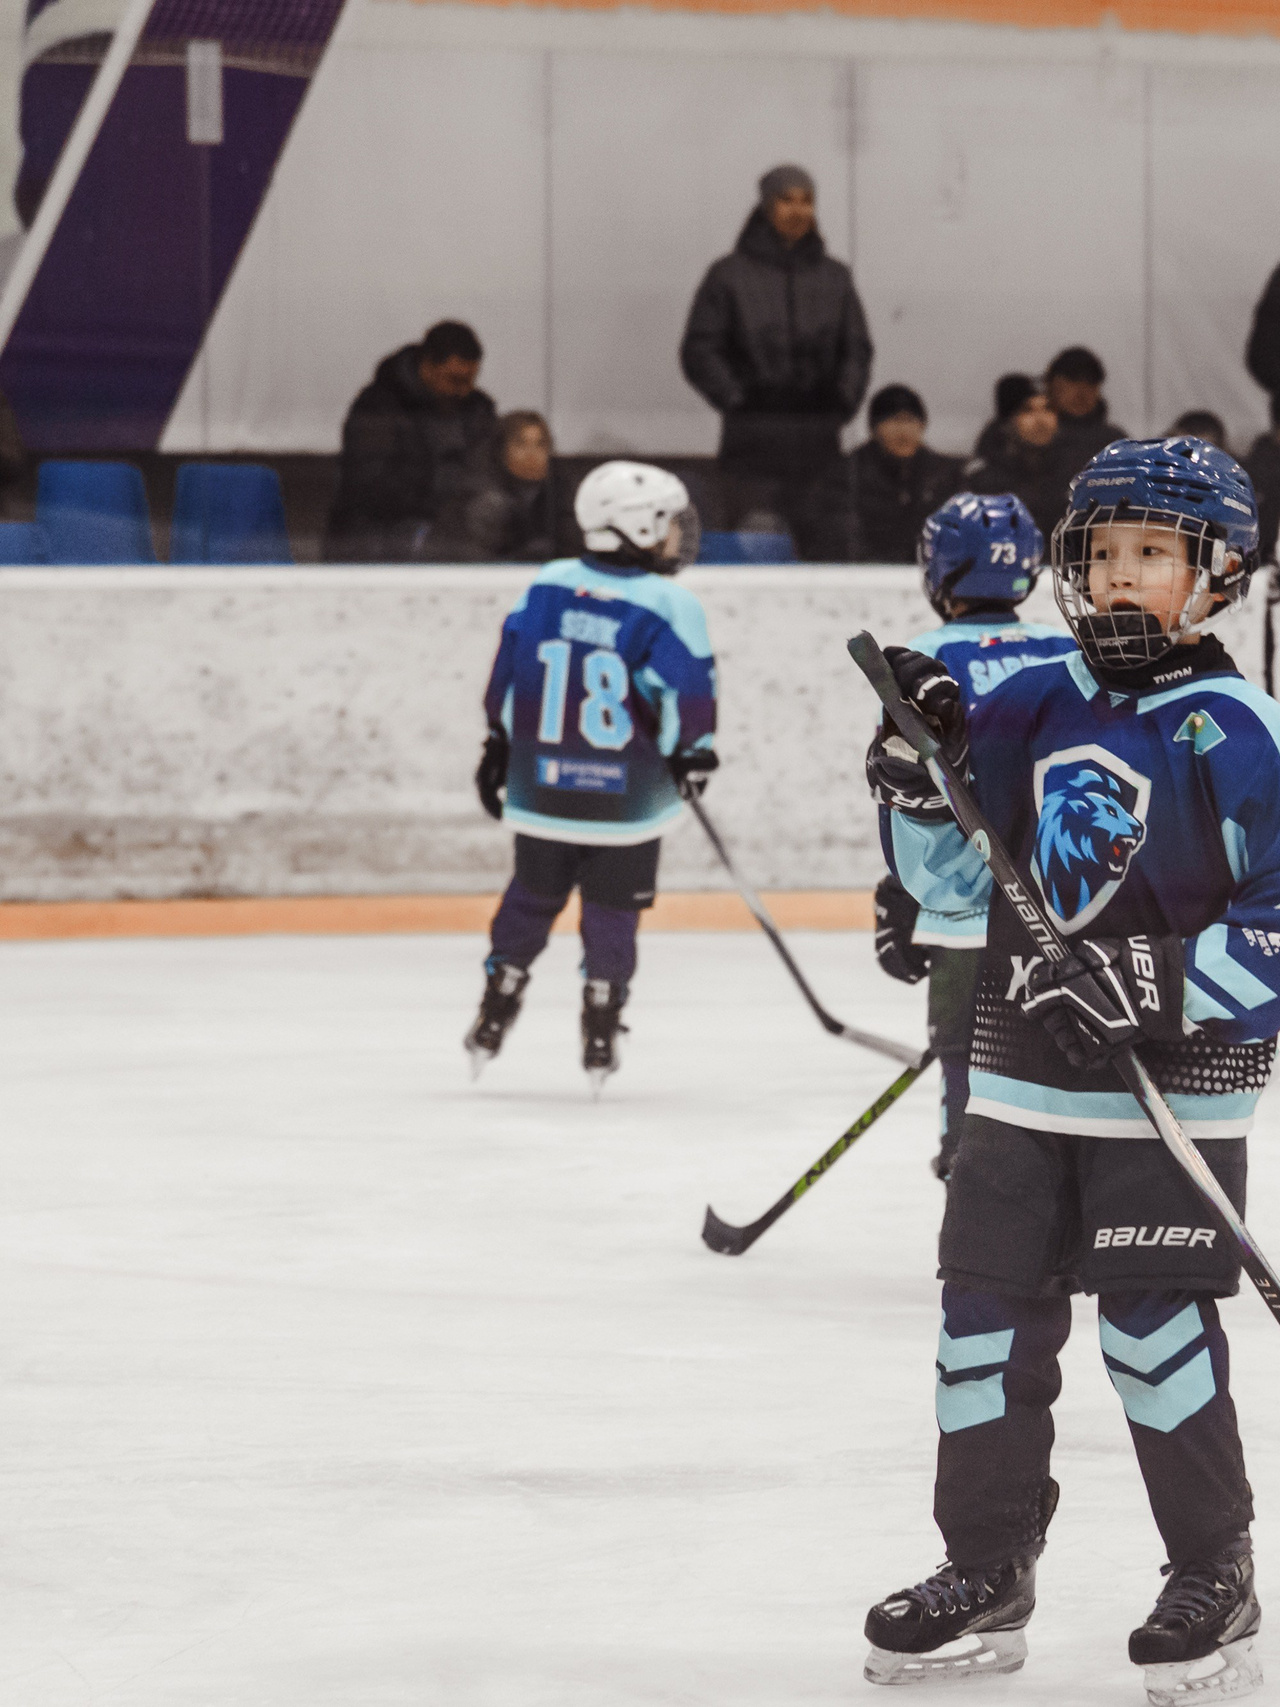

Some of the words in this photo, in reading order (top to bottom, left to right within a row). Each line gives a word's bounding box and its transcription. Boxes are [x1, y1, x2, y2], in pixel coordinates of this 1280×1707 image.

[990, 542, 1017, 565] 73
[537, 638, 634, 751] 18
[1004, 881, 1066, 963] AUER
[1093, 1226, 1217, 1249] BAUER
